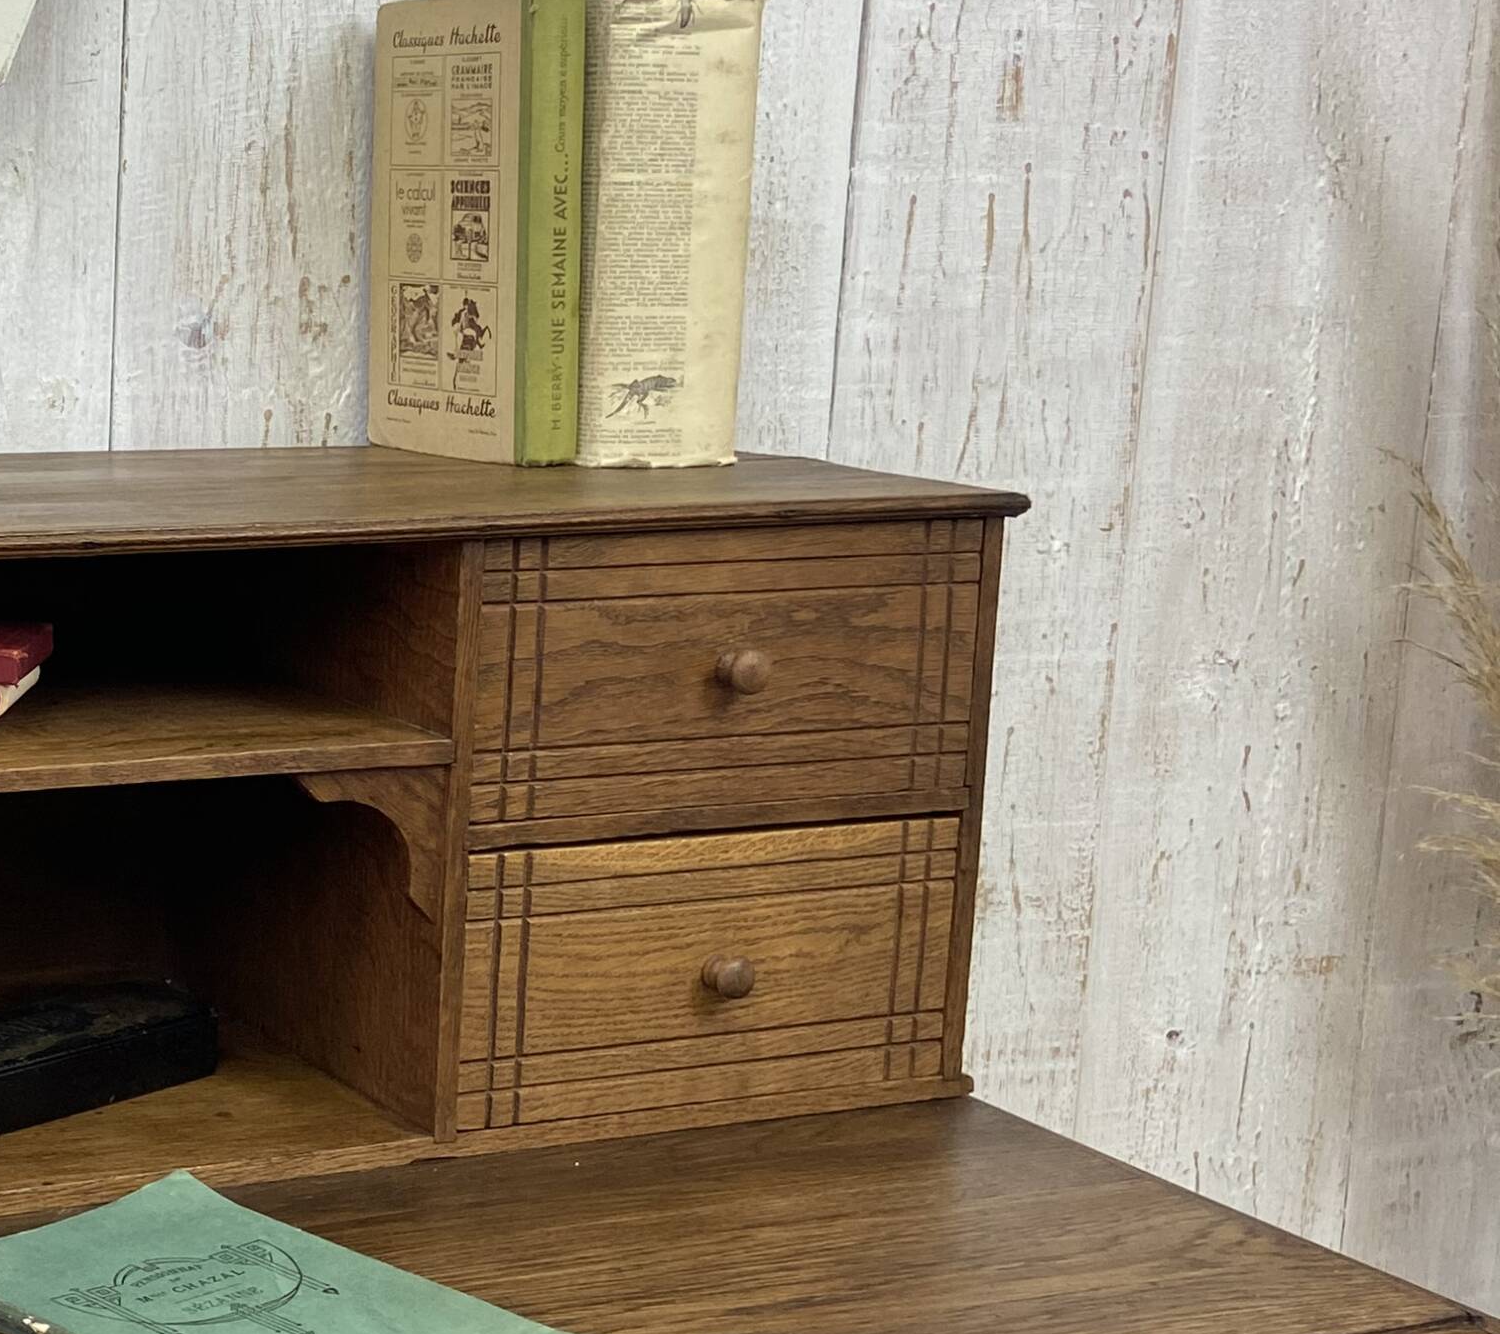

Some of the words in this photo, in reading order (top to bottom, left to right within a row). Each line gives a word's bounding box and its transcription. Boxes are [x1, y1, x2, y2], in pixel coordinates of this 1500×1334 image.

[392, 28, 444, 54] Classiques
[449, 23, 501, 46] Hachette
[557, 80, 569, 117] moyen
[554, 121, 566, 153] Cours
[395, 180, 405, 200] le
[406, 180, 436, 201] calcul
[450, 179, 491, 194] SCIENCES
[551, 227, 567, 311] SEMAINE
[551, 317, 566, 354] UNE
[550, 363, 563, 411] BERRY
[387, 389, 440, 415] Classiques
[445, 395, 497, 419] Hachette
[171, 1269, 246, 1293] CHAZAL
